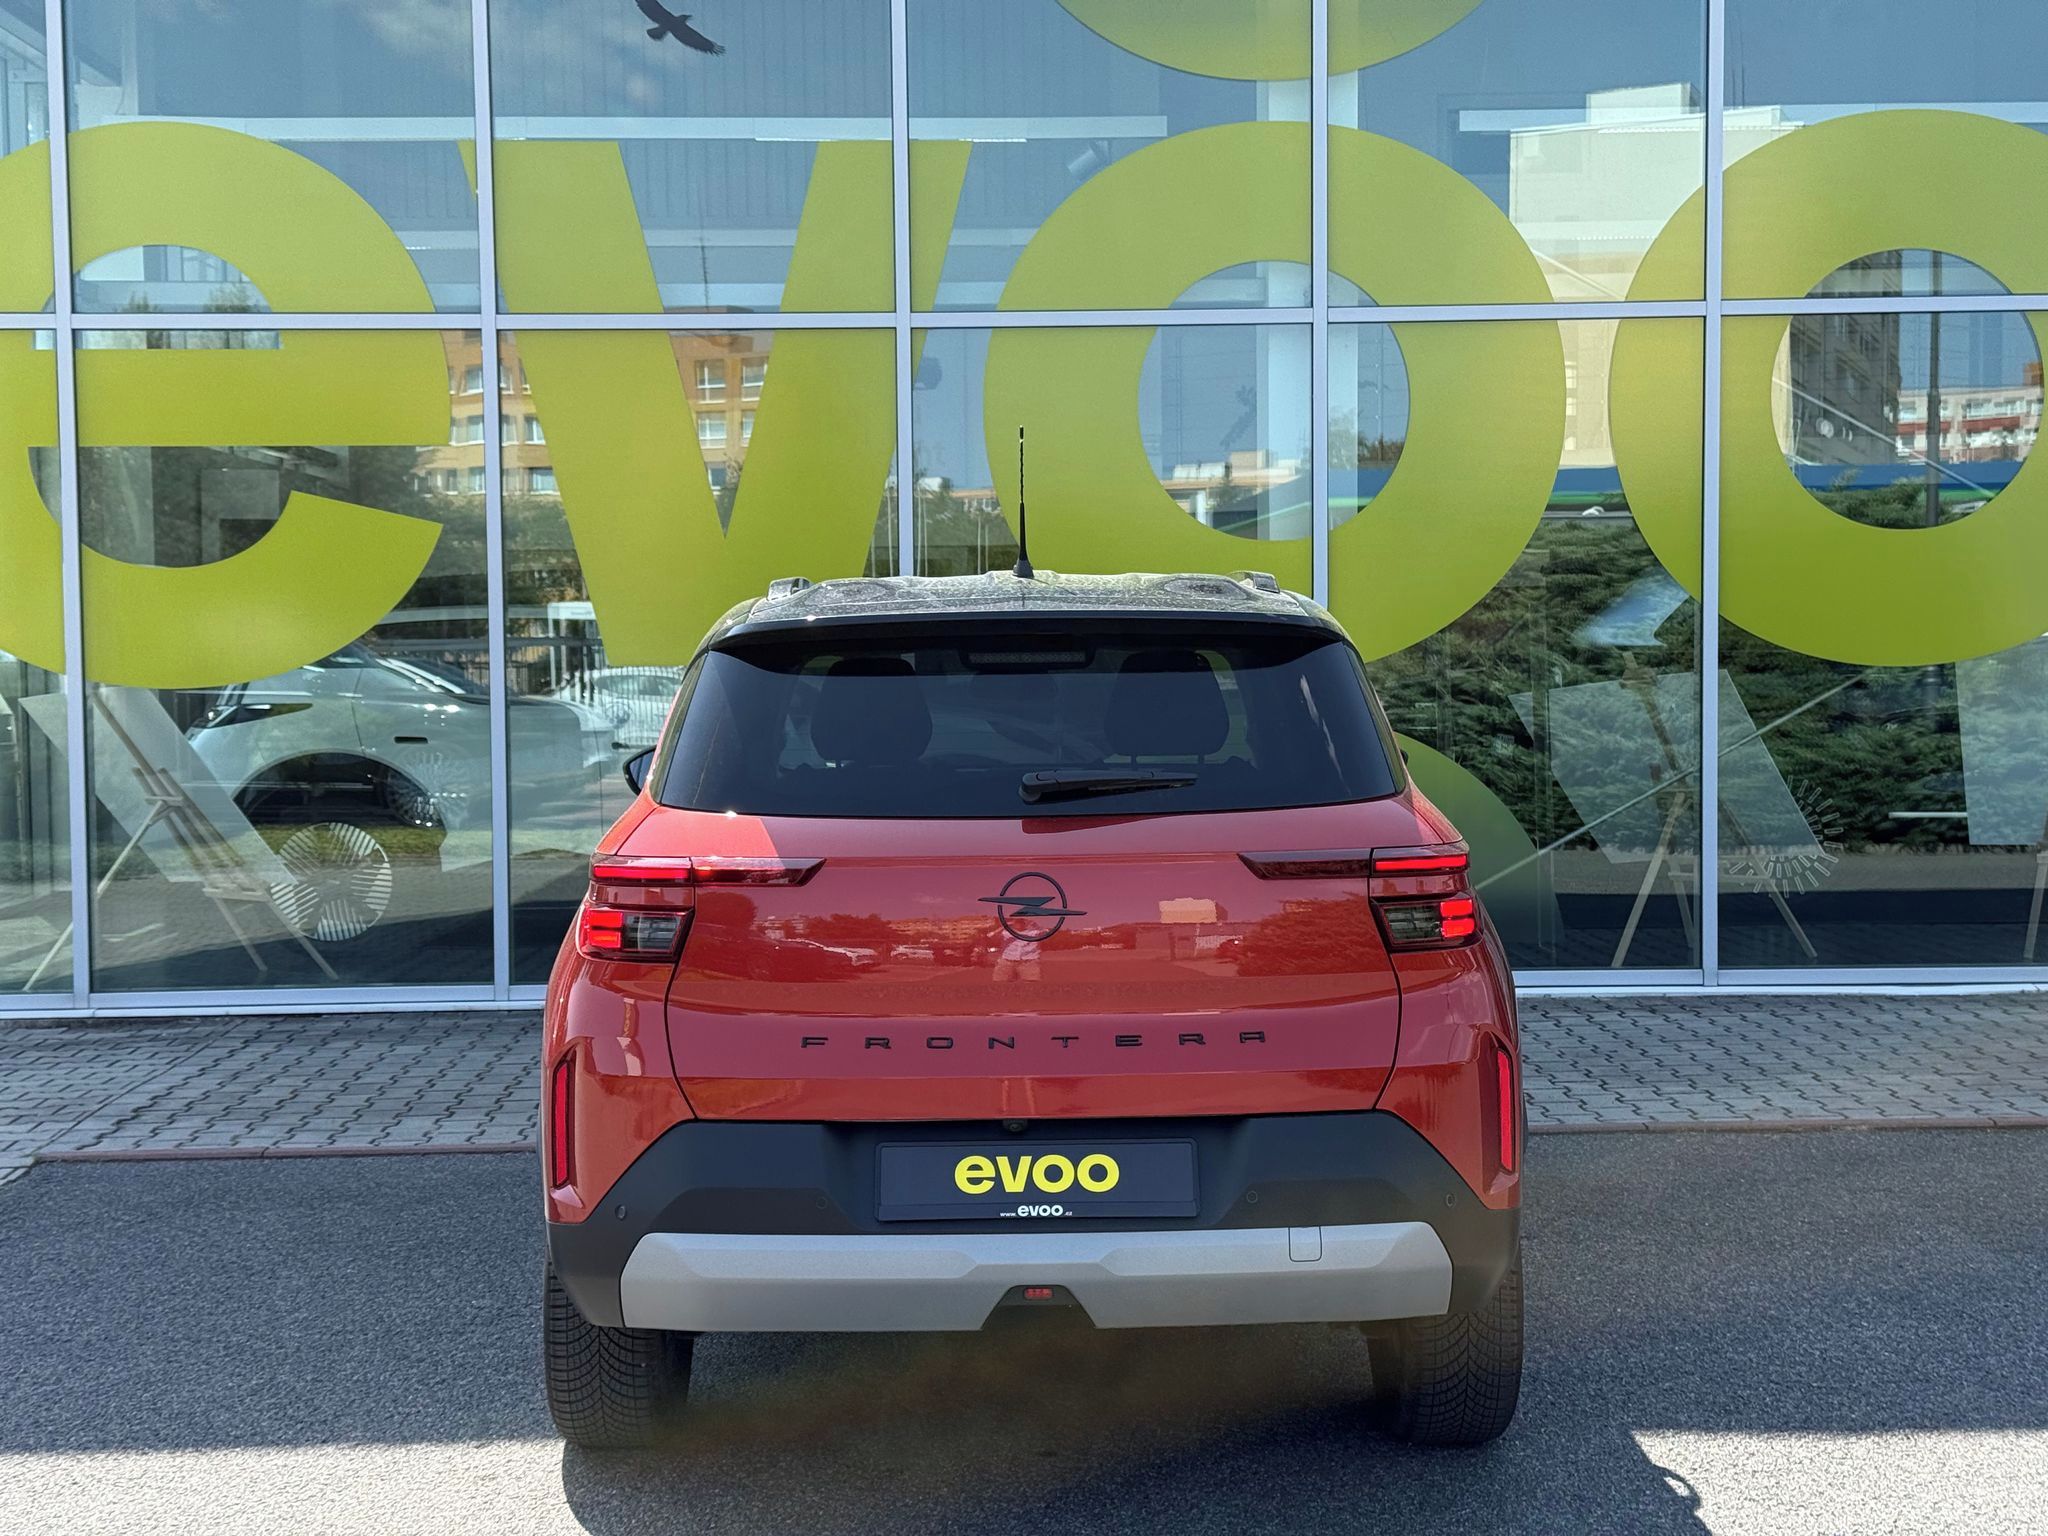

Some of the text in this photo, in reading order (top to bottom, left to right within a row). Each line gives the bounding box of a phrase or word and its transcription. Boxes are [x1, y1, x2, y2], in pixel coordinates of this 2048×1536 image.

[0, 109, 2048, 689] evoo
[801, 1030, 1267, 1050] FRONTERA
[954, 1153, 1120, 1195] evoo
